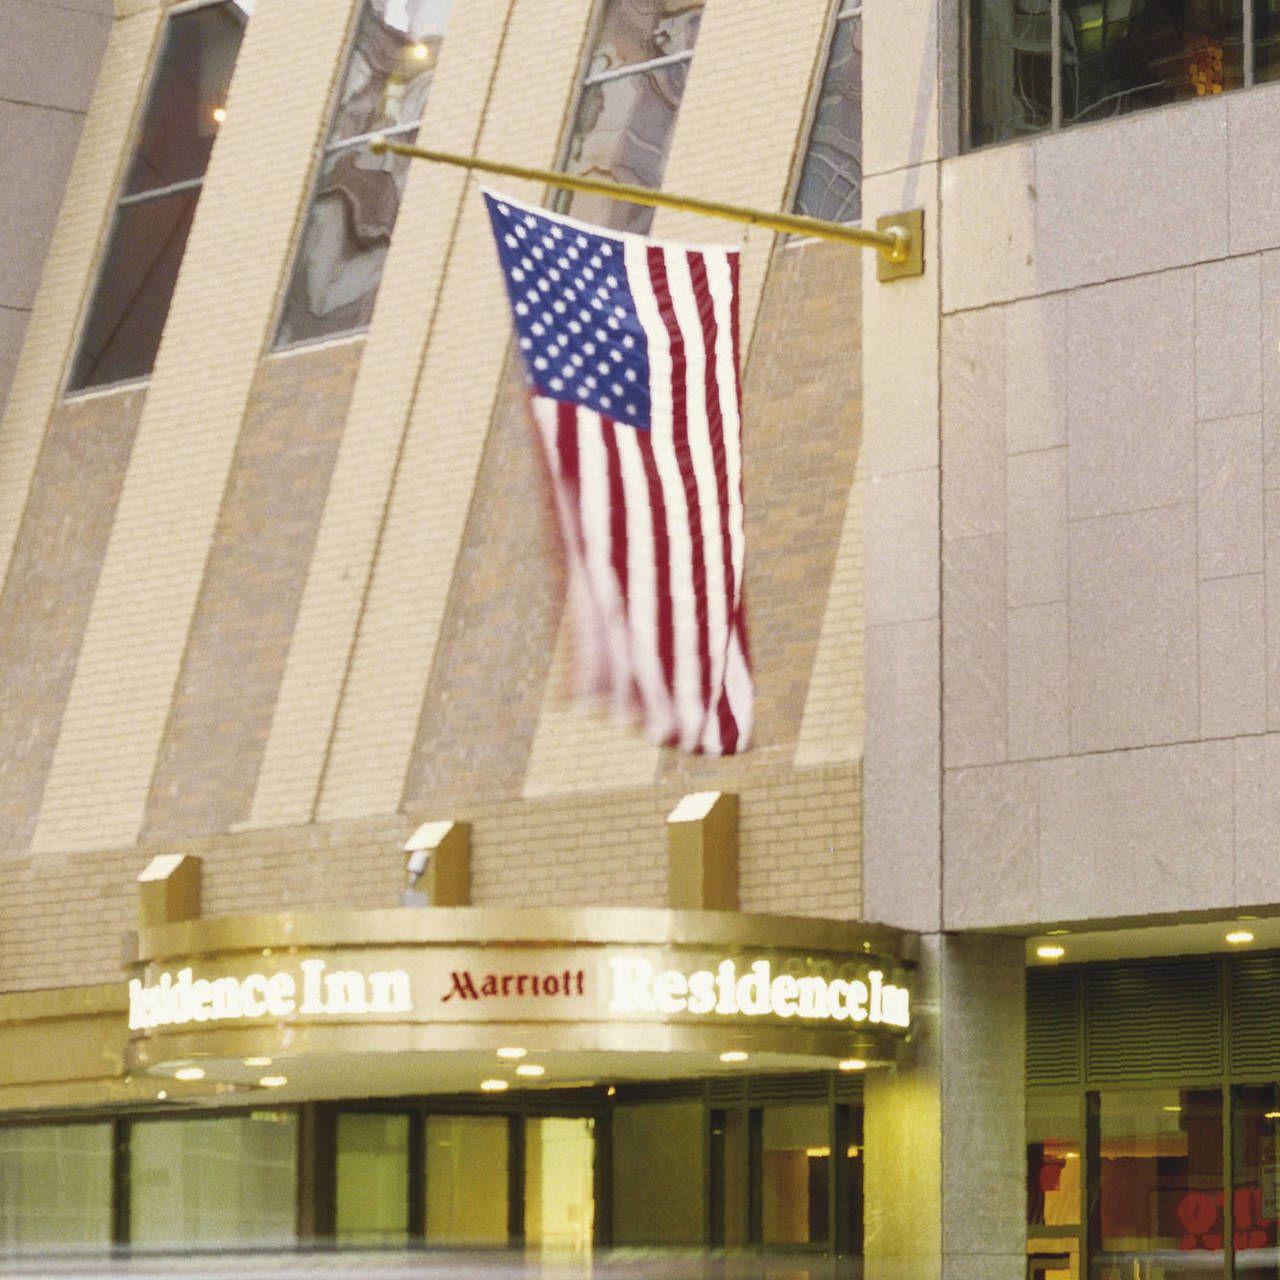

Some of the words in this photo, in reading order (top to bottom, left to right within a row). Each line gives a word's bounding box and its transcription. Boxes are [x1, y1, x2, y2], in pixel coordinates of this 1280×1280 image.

[300, 959, 413, 1015] Inn
[440, 970, 584, 1003] Marriott
[609, 956, 868, 1022] Residence
